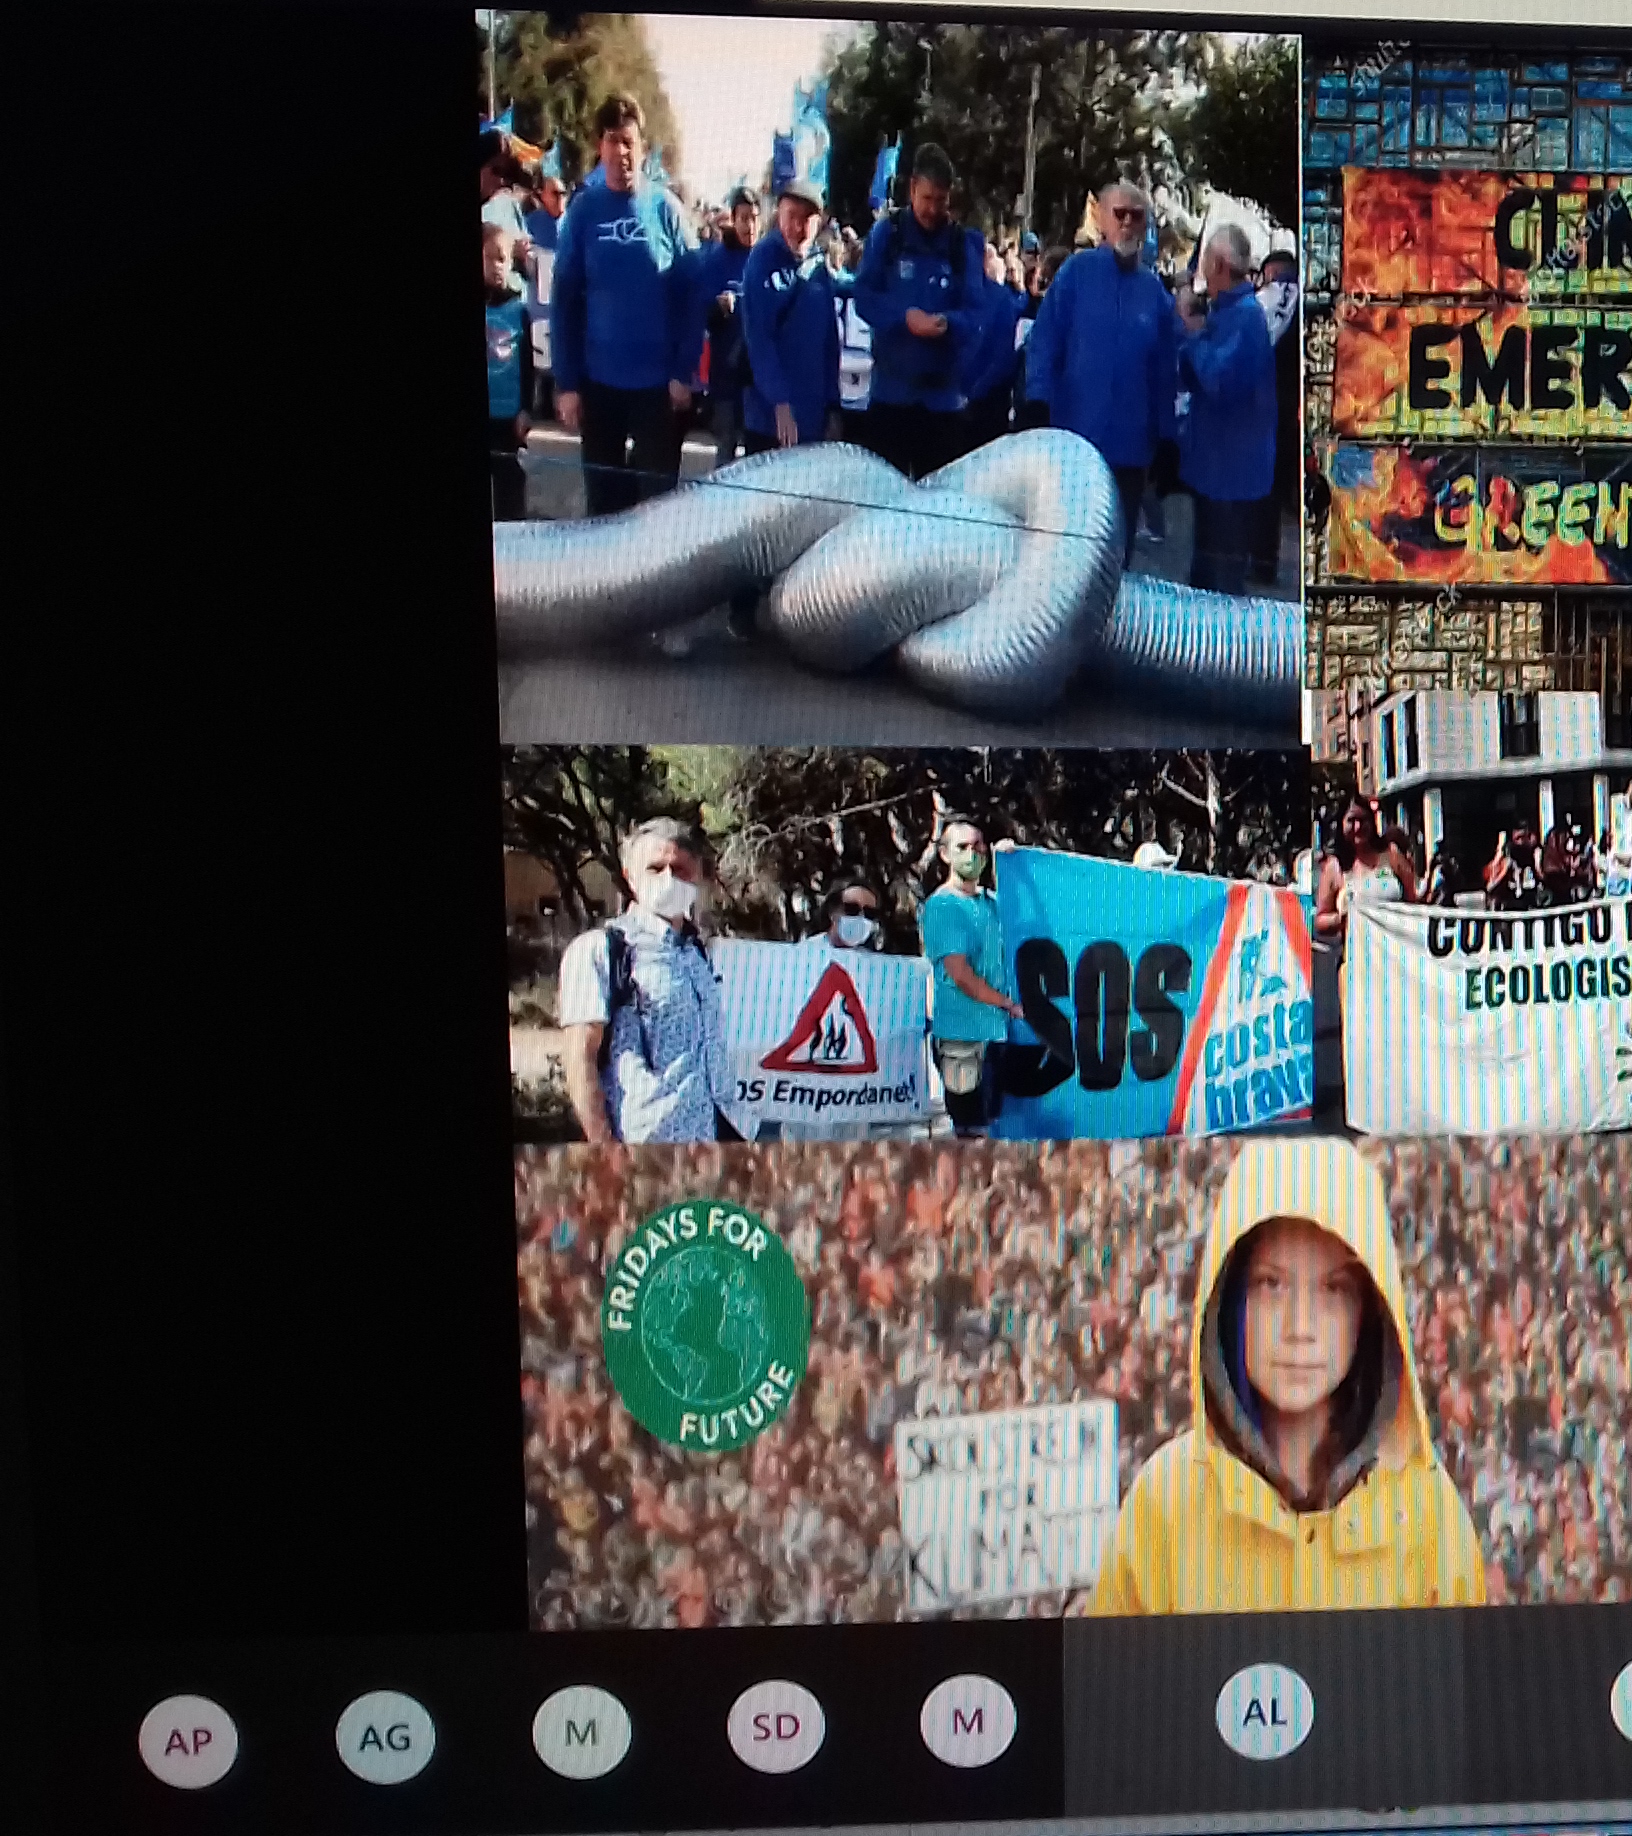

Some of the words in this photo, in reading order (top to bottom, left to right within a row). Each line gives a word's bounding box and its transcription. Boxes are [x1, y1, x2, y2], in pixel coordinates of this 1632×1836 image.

[1000, 936, 1194, 1098] SOS
[606, 1207, 699, 1333] FRIDAYS
[707, 1206, 768, 1262] FOR
[679, 1360, 794, 1446] FUTURE
[752, 1712, 801, 1742] SD
[952, 1707, 986, 1736] M
[1242, 1697, 1288, 1727] AL
[163, 1727, 214, 1756] AP
[358, 1724, 413, 1753] AG
[565, 1719, 599, 1747] M
